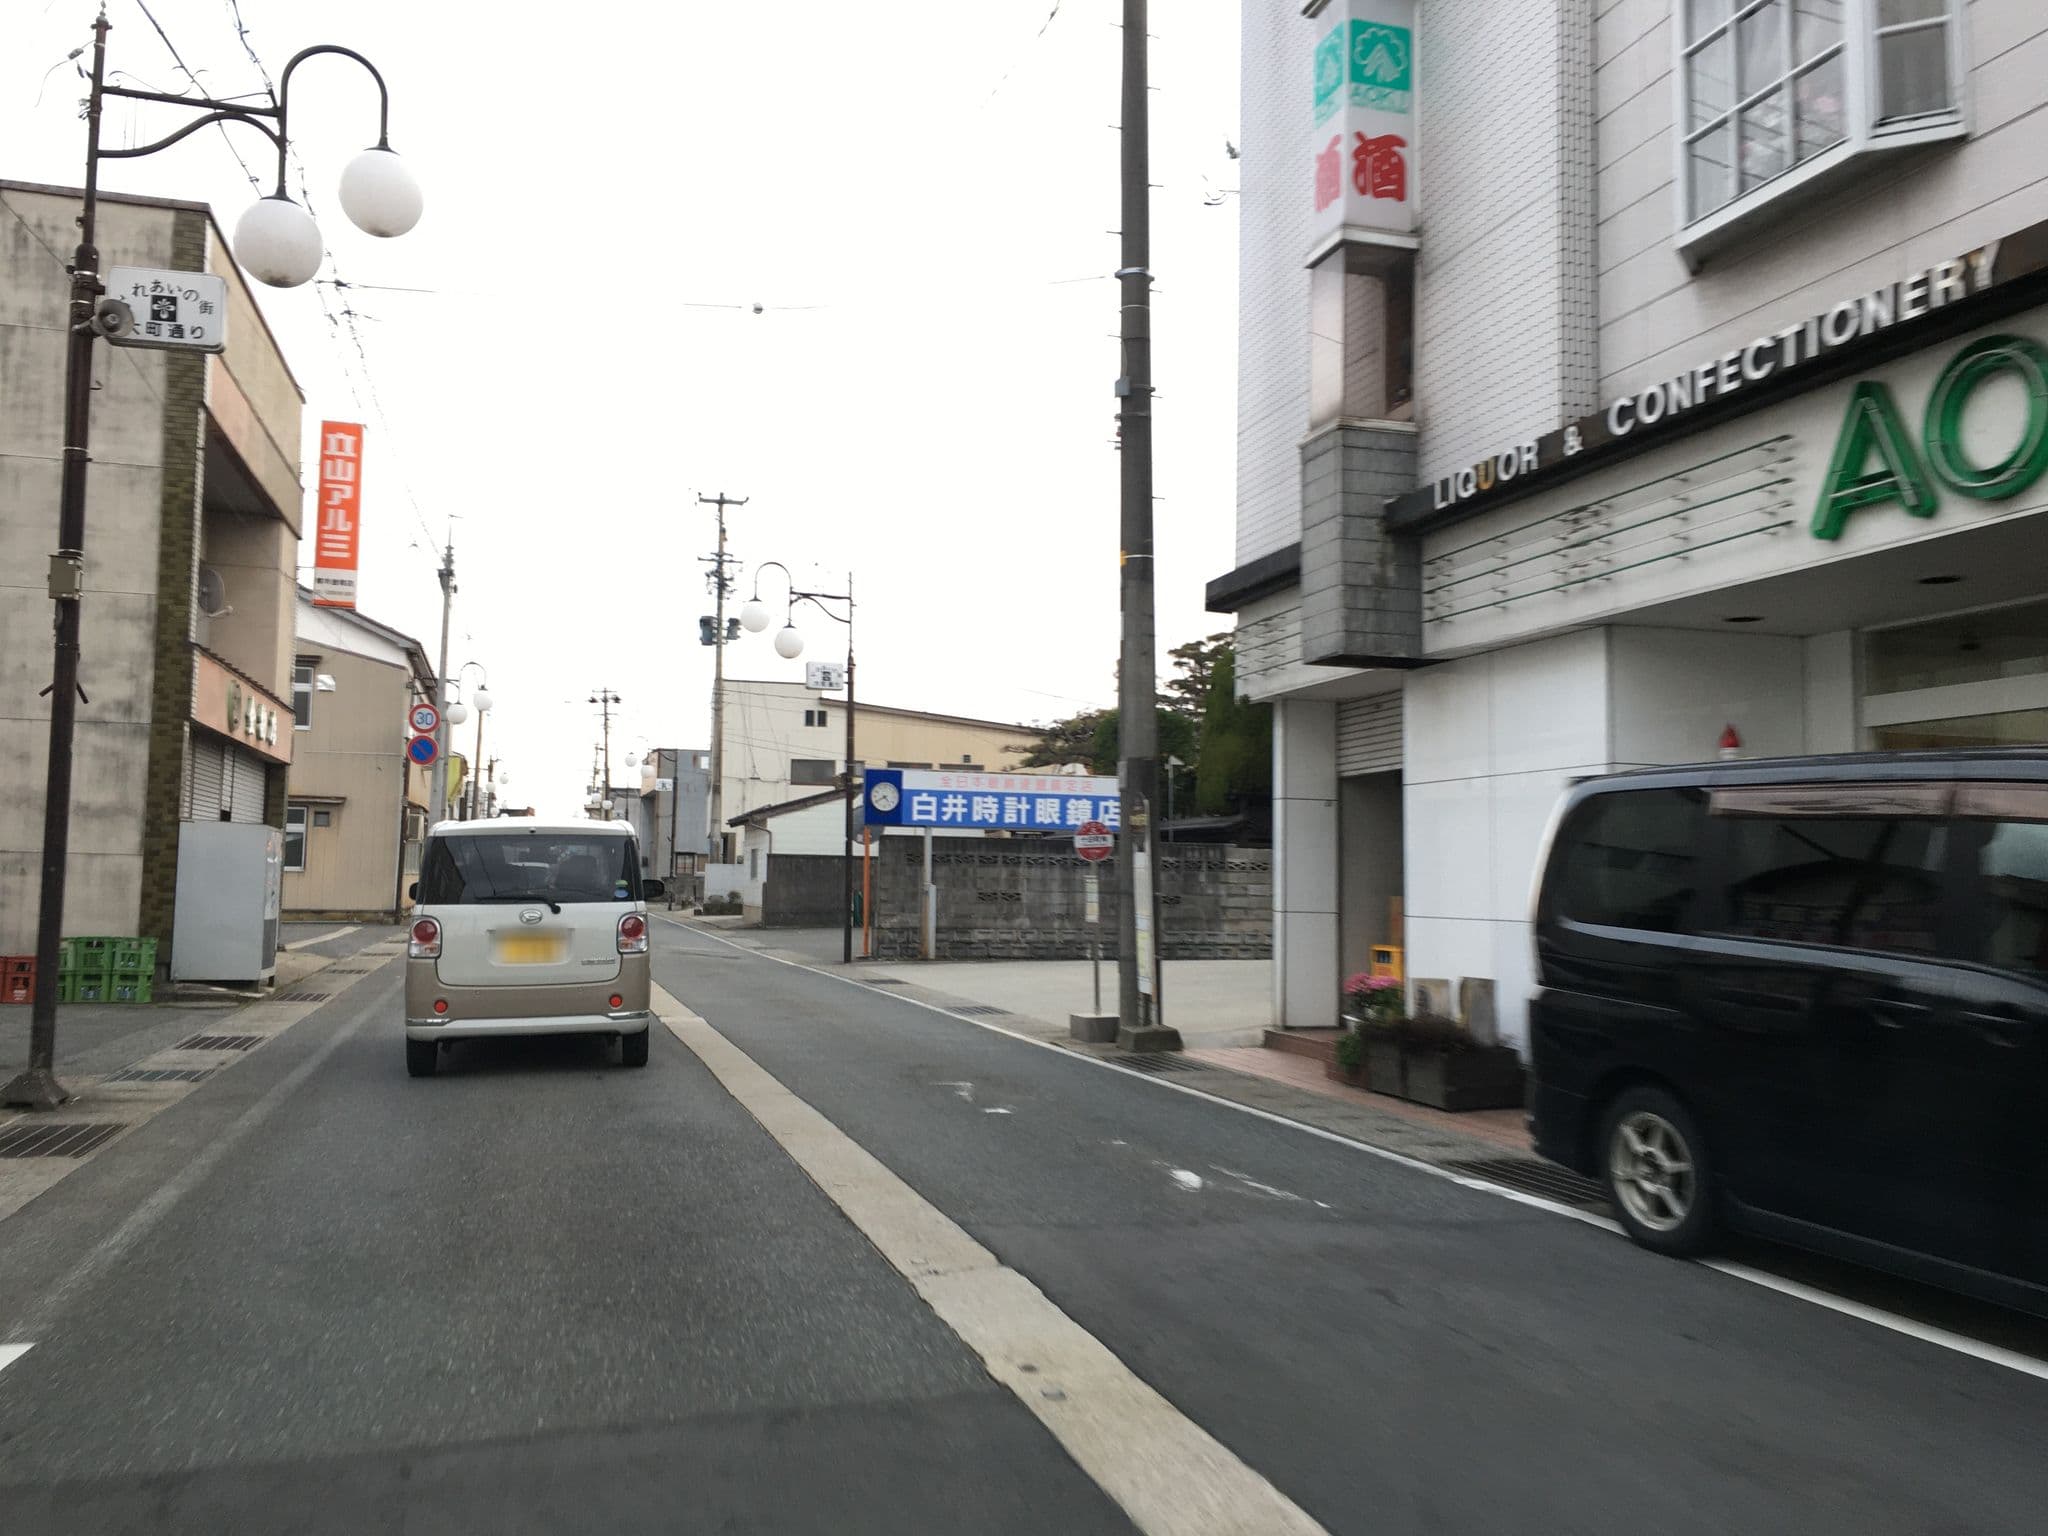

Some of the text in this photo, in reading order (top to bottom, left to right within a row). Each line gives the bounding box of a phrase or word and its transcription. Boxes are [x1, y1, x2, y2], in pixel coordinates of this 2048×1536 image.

[1353, 131, 1408, 202] 酒
[120, 280, 214, 315] れあいの街
[1433, 240, 2001, 510] LIQUOR & CONFECTIONERY
[321, 432, 357, 559] 立山アルミ
[415, 711, 434, 726] 30
[911, 792, 1121, 827] 白井時計眼鏡店
